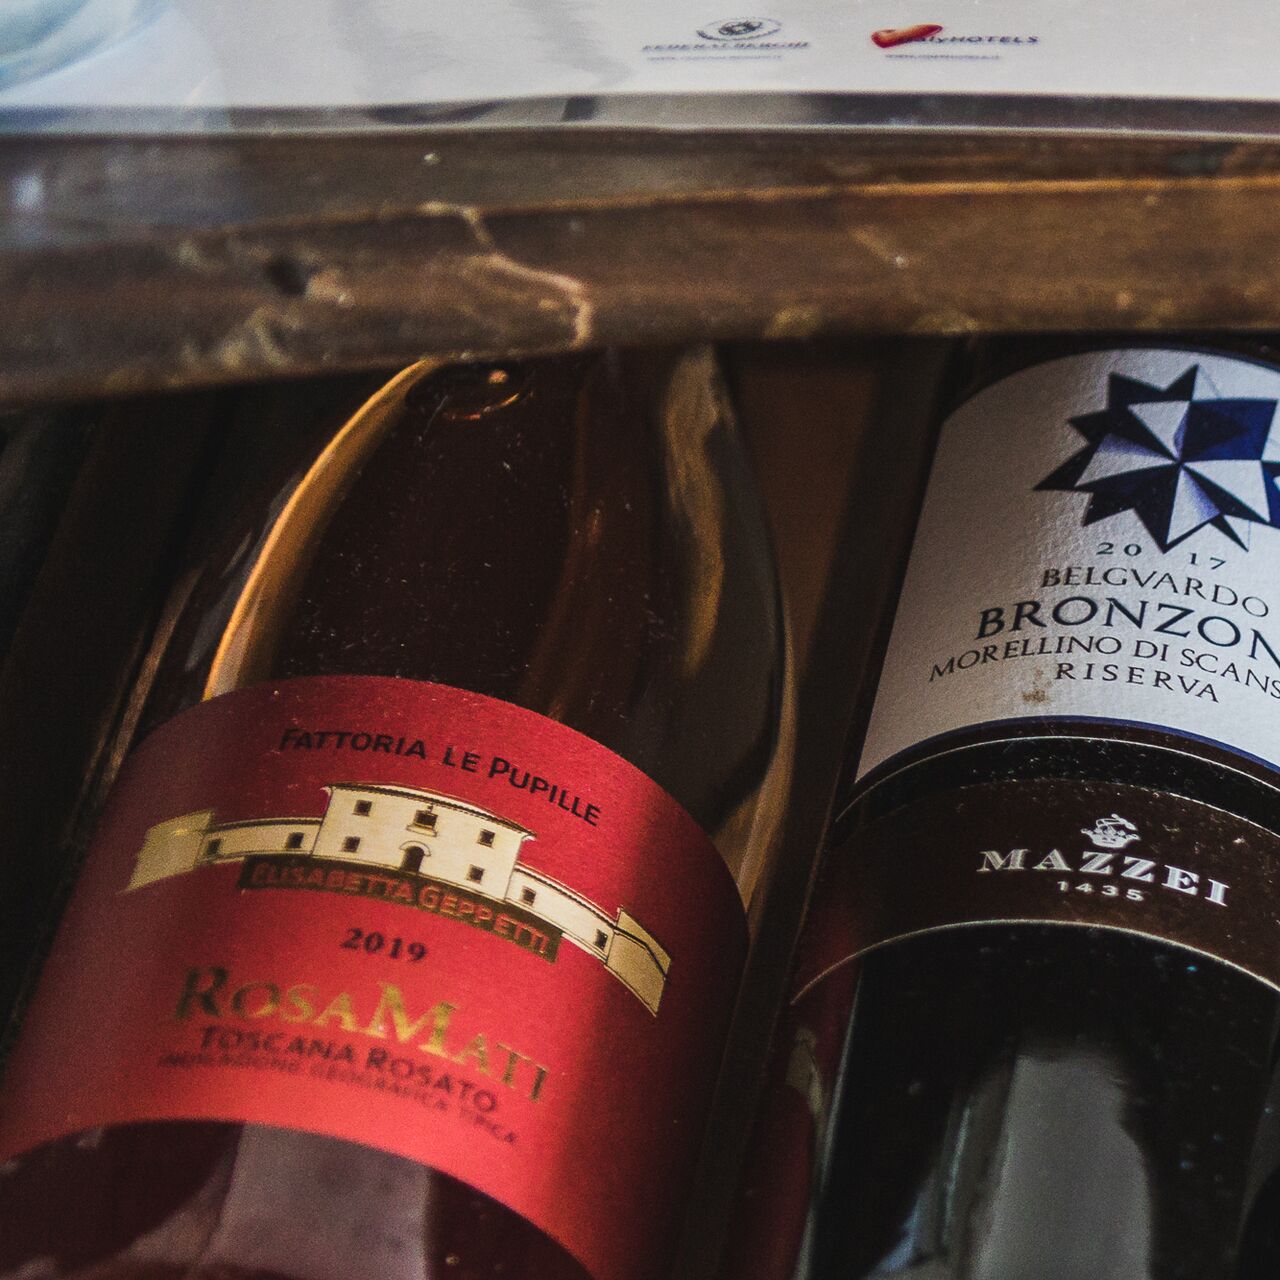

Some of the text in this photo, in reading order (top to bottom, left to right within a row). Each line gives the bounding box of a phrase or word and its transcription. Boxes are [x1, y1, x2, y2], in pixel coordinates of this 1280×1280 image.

[1041, 566, 1270, 618] BELGVARDO
[928, 636, 1122, 683] MORELLINO
[1133, 640, 1169, 663] DI
[1054, 662, 1219, 703] RISERVA
[279, 729, 601, 826] FATTORIA LE PUPILLE
[976, 848, 1229, 907] MAZZEI
[1056, 879, 1145, 902] 1435
[341, 927, 428, 962] 2019
[200, 1025, 498, 1114] TOSCANA ROSATO
